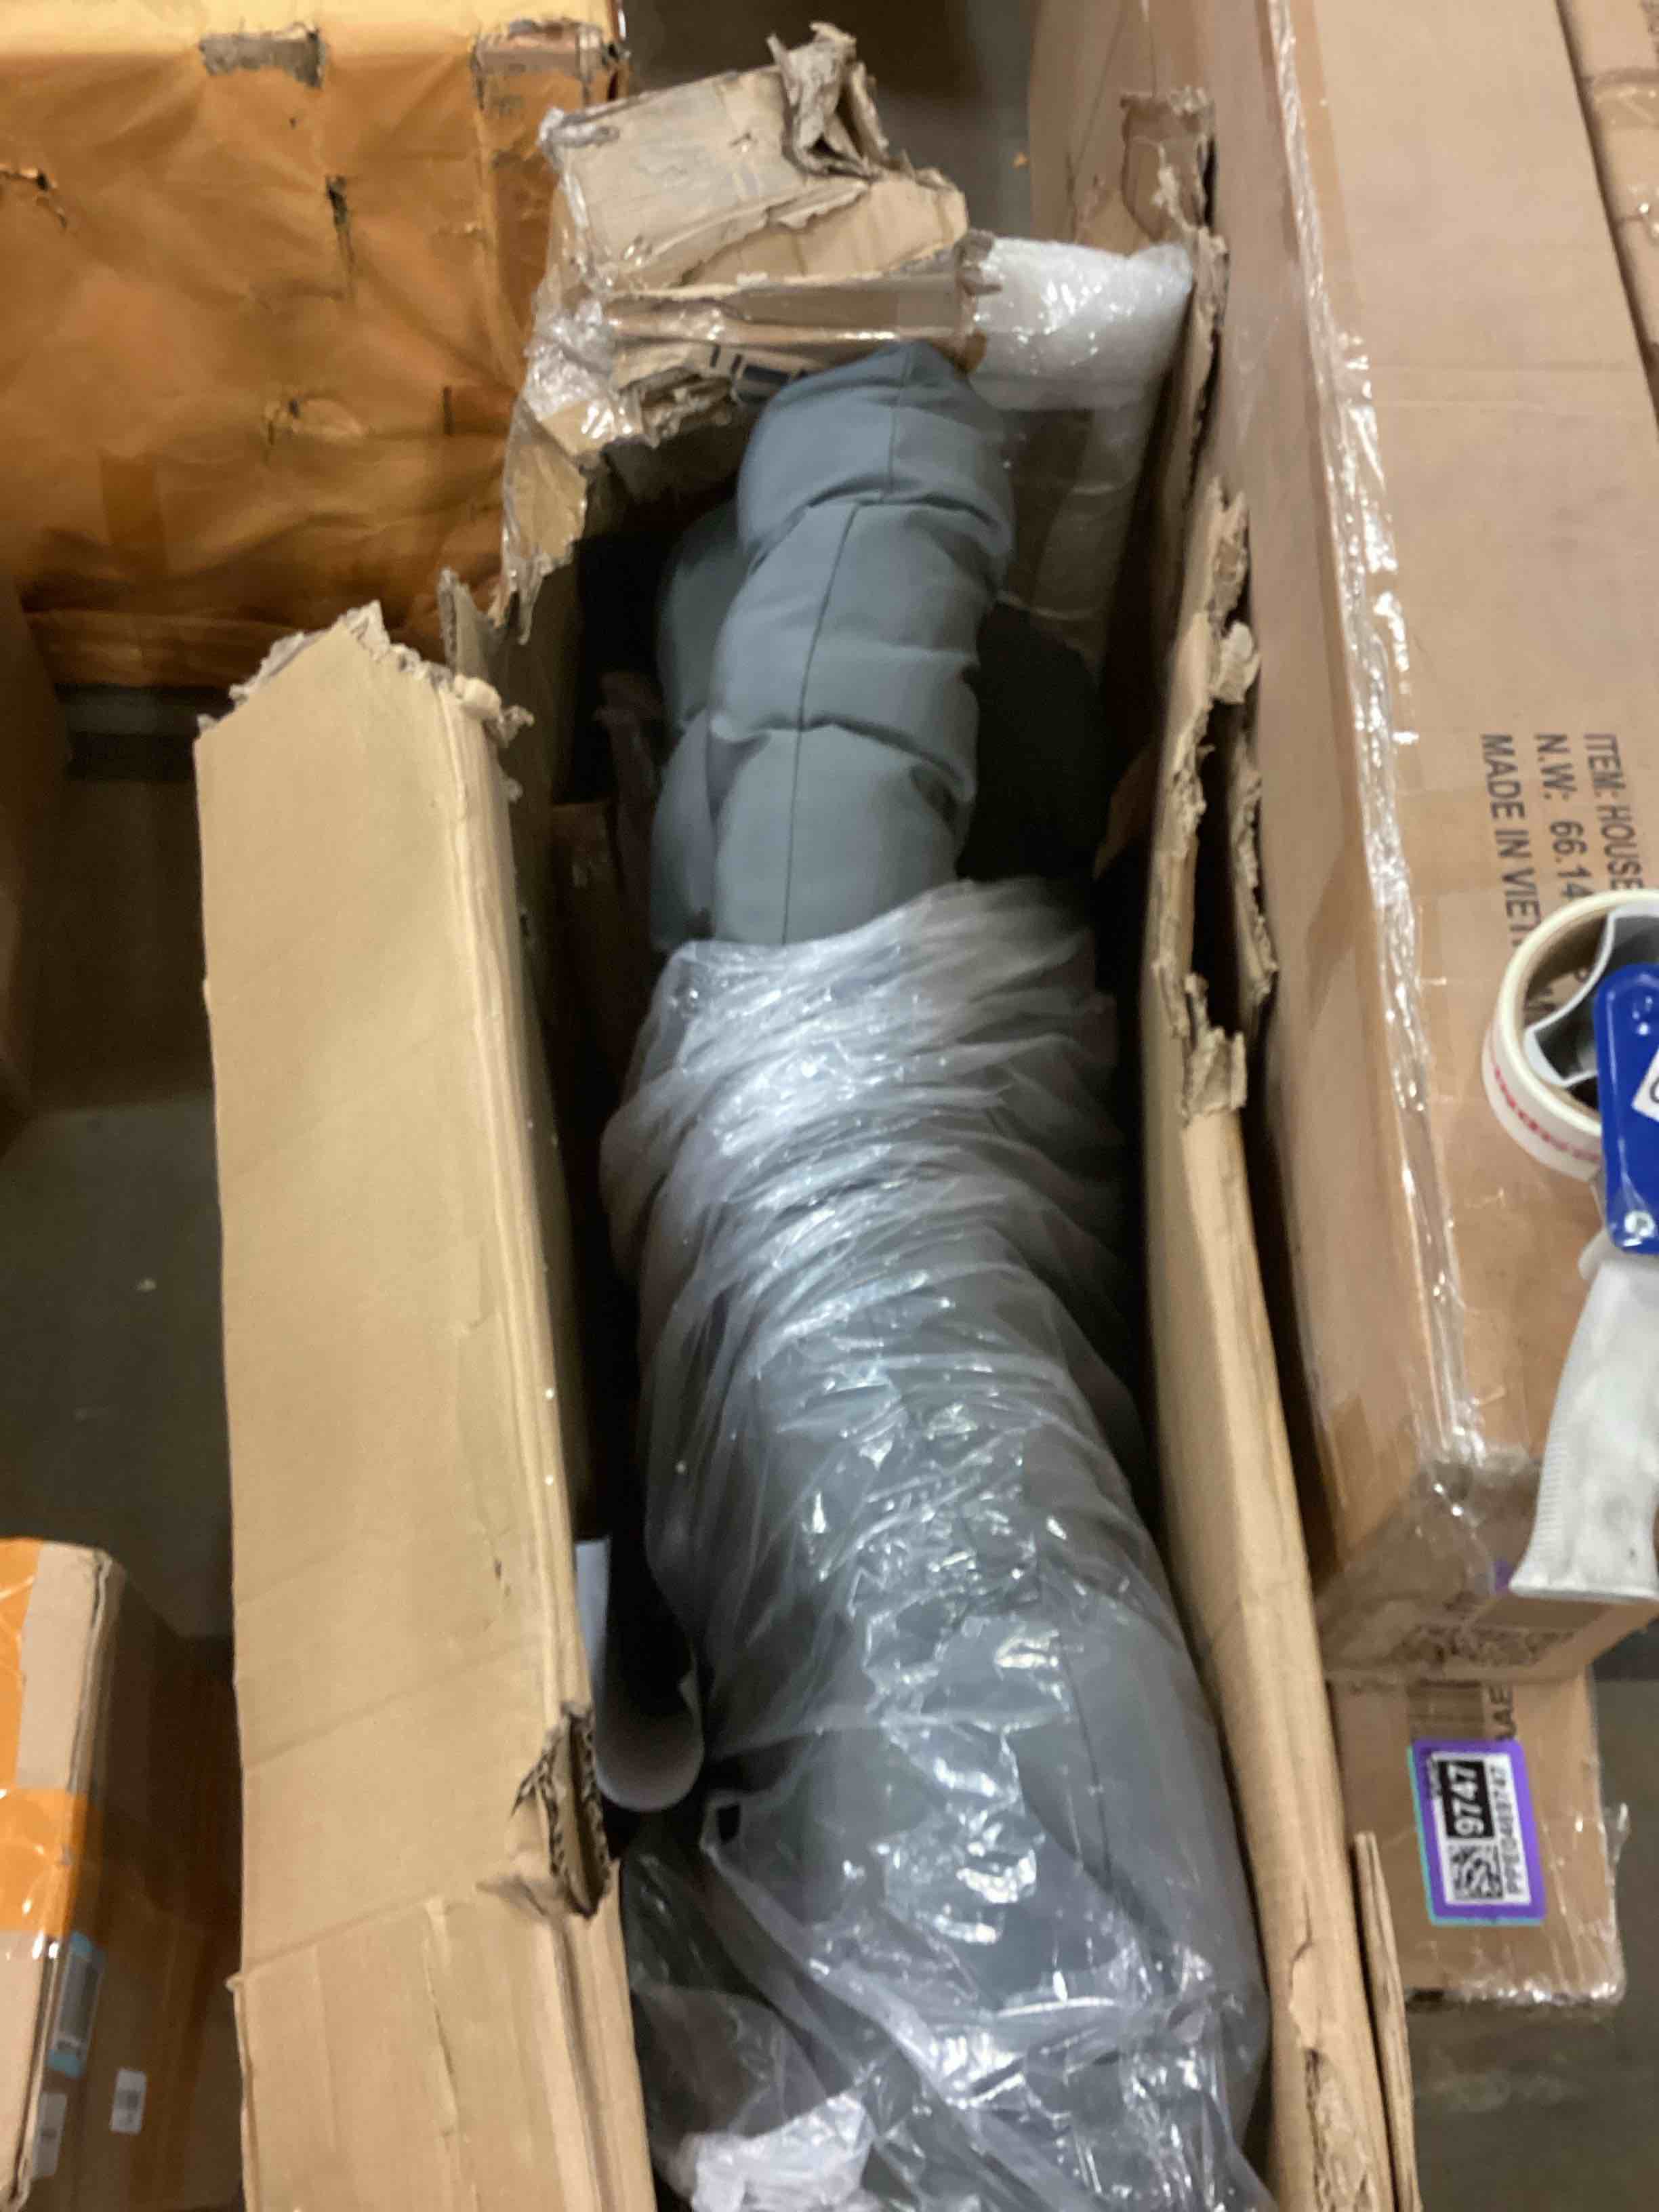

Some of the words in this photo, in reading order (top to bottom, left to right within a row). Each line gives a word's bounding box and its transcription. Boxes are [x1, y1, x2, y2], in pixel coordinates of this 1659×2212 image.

[1480, 733, 1525, 820] MADE
[1534, 733, 1578, 801] N.W:
[1584, 733, 1626, 798] ITEM:
[1494, 830, 1532, 859] IN
[1502, 867, 1541, 947] VIET
[1446, 1763, 1485, 1837] 9747
